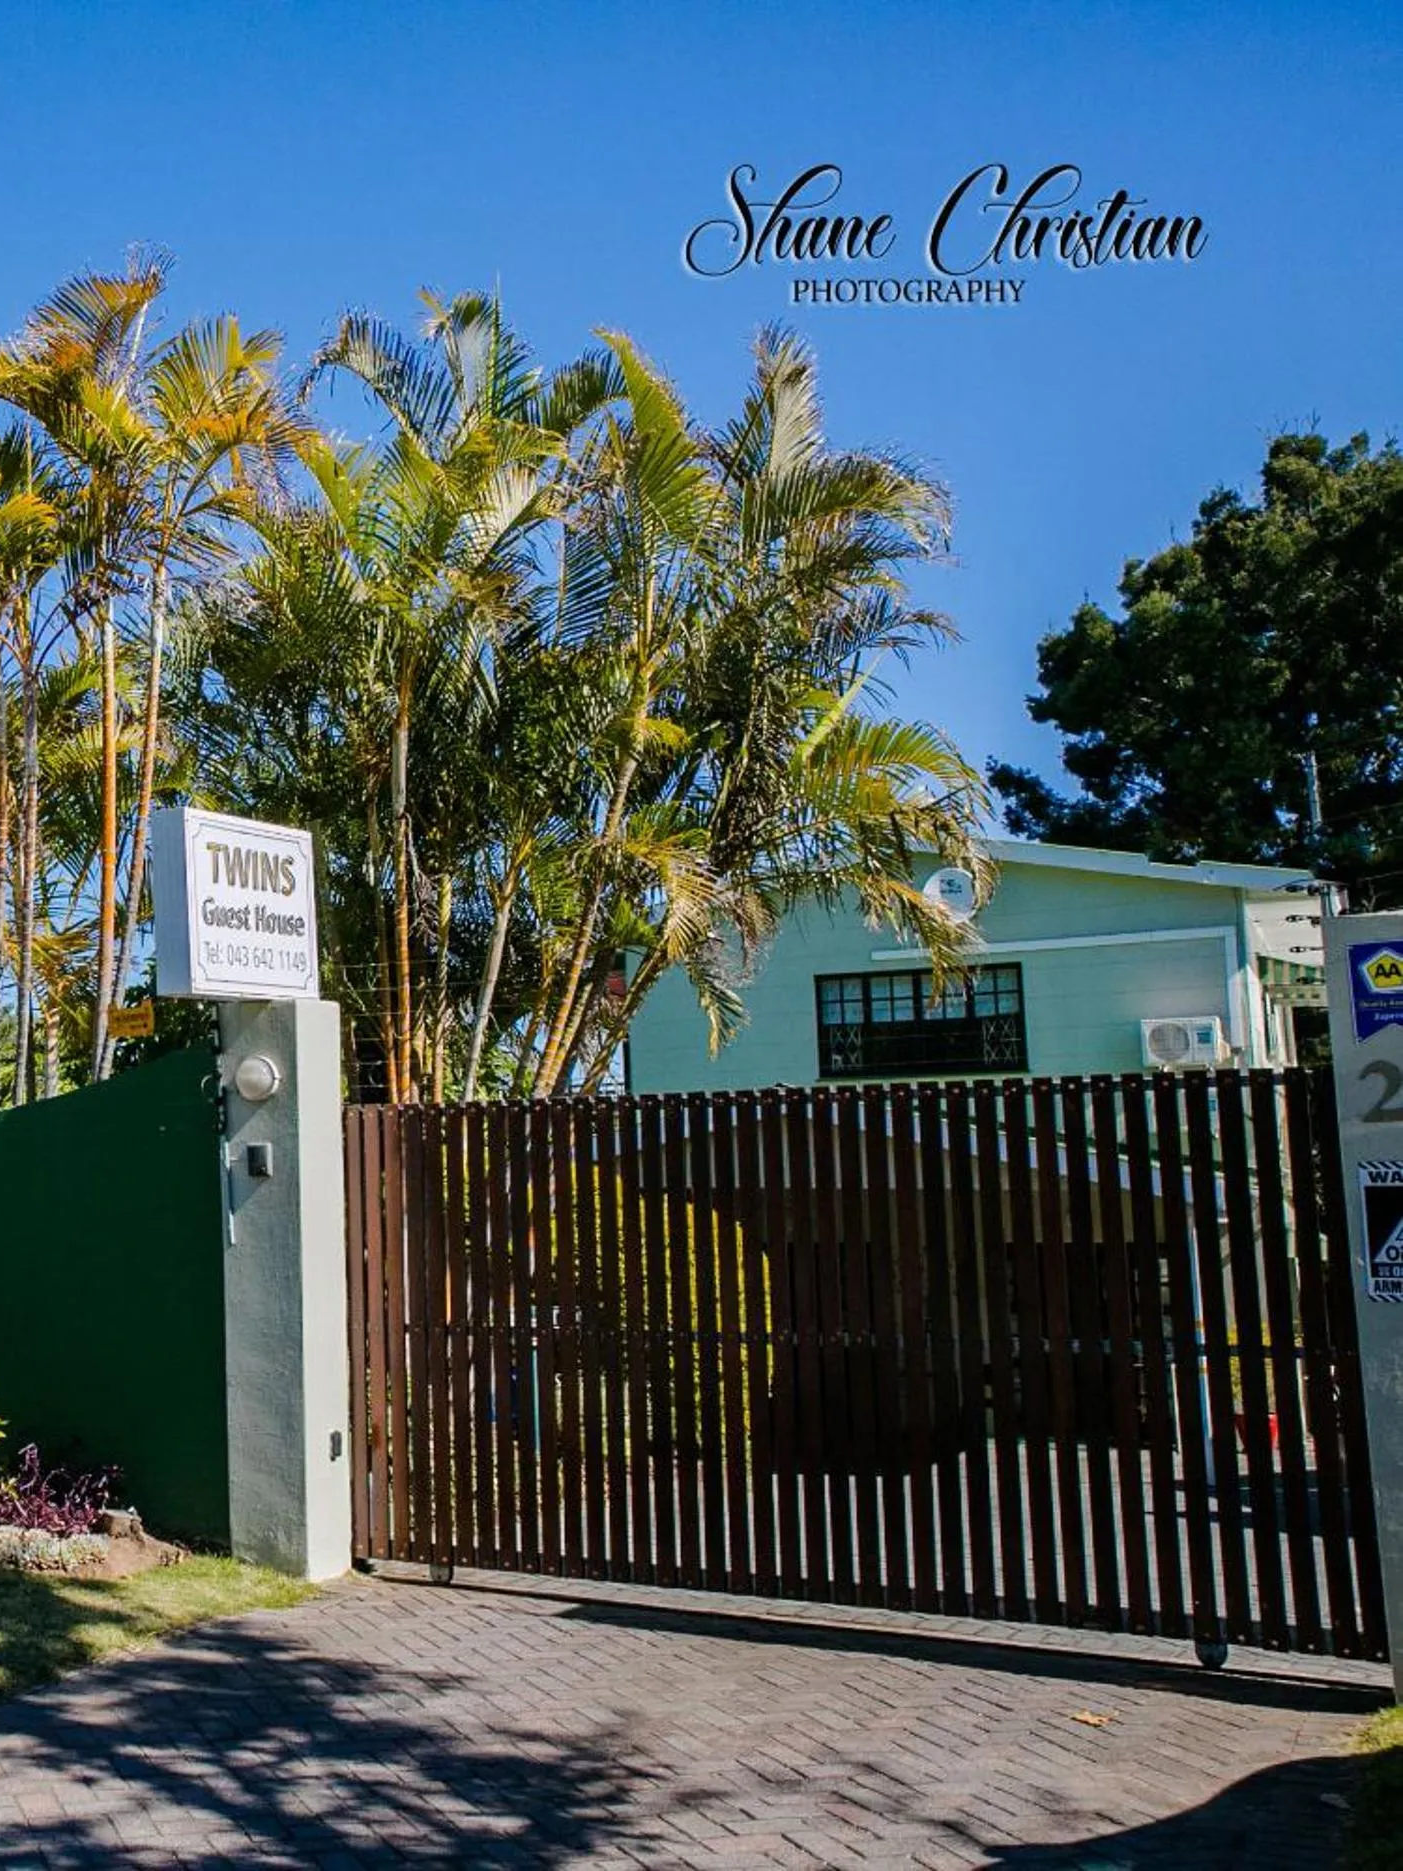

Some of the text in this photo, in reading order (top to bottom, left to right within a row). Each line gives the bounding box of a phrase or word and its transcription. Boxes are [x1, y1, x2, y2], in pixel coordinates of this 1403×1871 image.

[206, 841, 296, 897] TWINS
[202, 896, 306, 937] Guest House
[227, 943, 249, 967] 043
[253, 946, 275, 970] 642
[279, 950, 307, 973] 1149
[1375, 963, 1402, 979] AA
